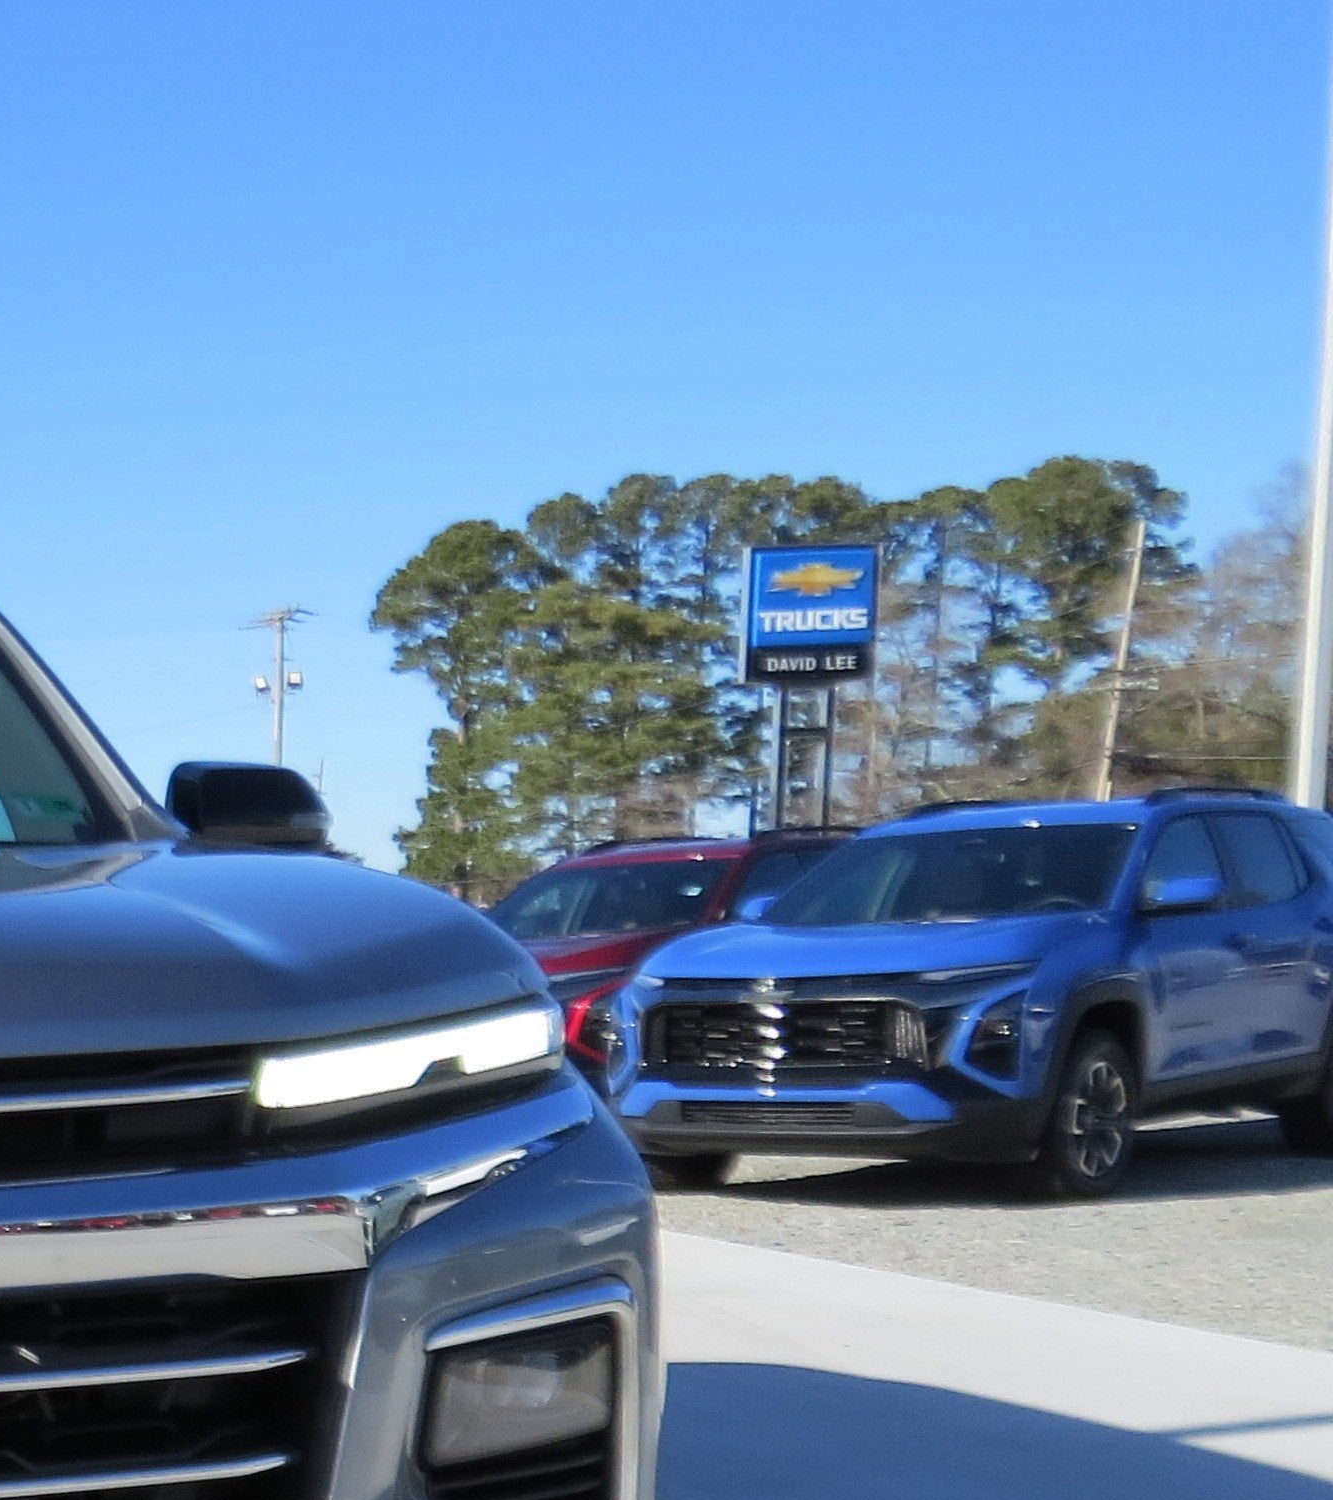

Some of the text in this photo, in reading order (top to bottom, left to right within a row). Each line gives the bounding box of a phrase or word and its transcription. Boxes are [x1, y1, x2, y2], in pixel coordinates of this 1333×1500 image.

[760, 608, 868, 632] TRUCKS
[766, 655, 858, 672] DAVID LEE
